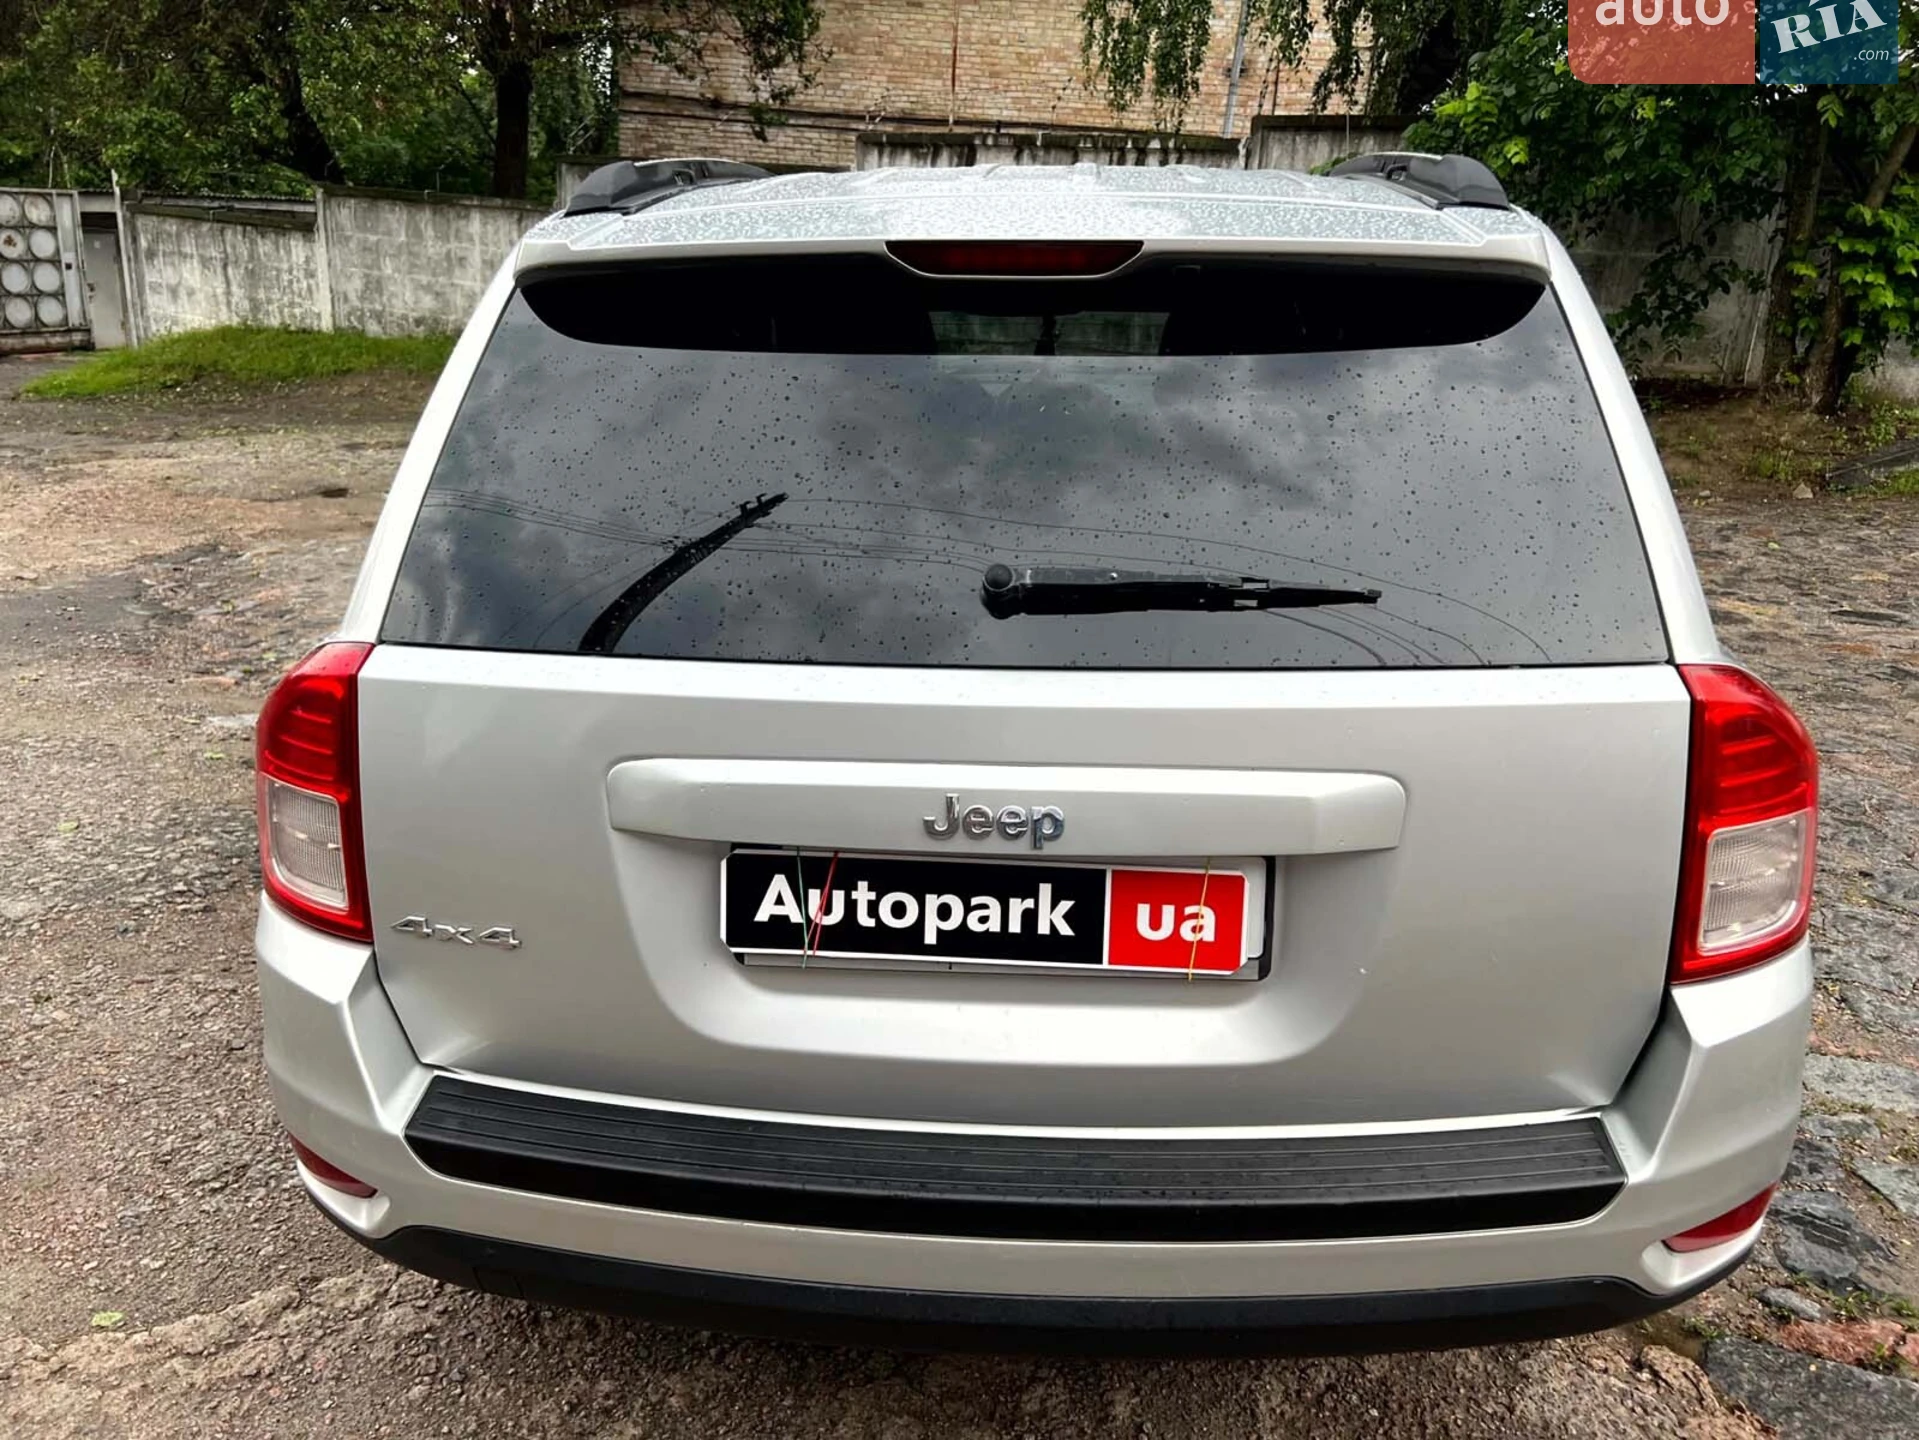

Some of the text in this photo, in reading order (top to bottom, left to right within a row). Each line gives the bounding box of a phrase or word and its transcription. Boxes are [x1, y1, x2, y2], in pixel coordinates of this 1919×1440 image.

[922, 793, 1066, 850] Jeep
[753, 873, 1217, 945] Autopark ua
